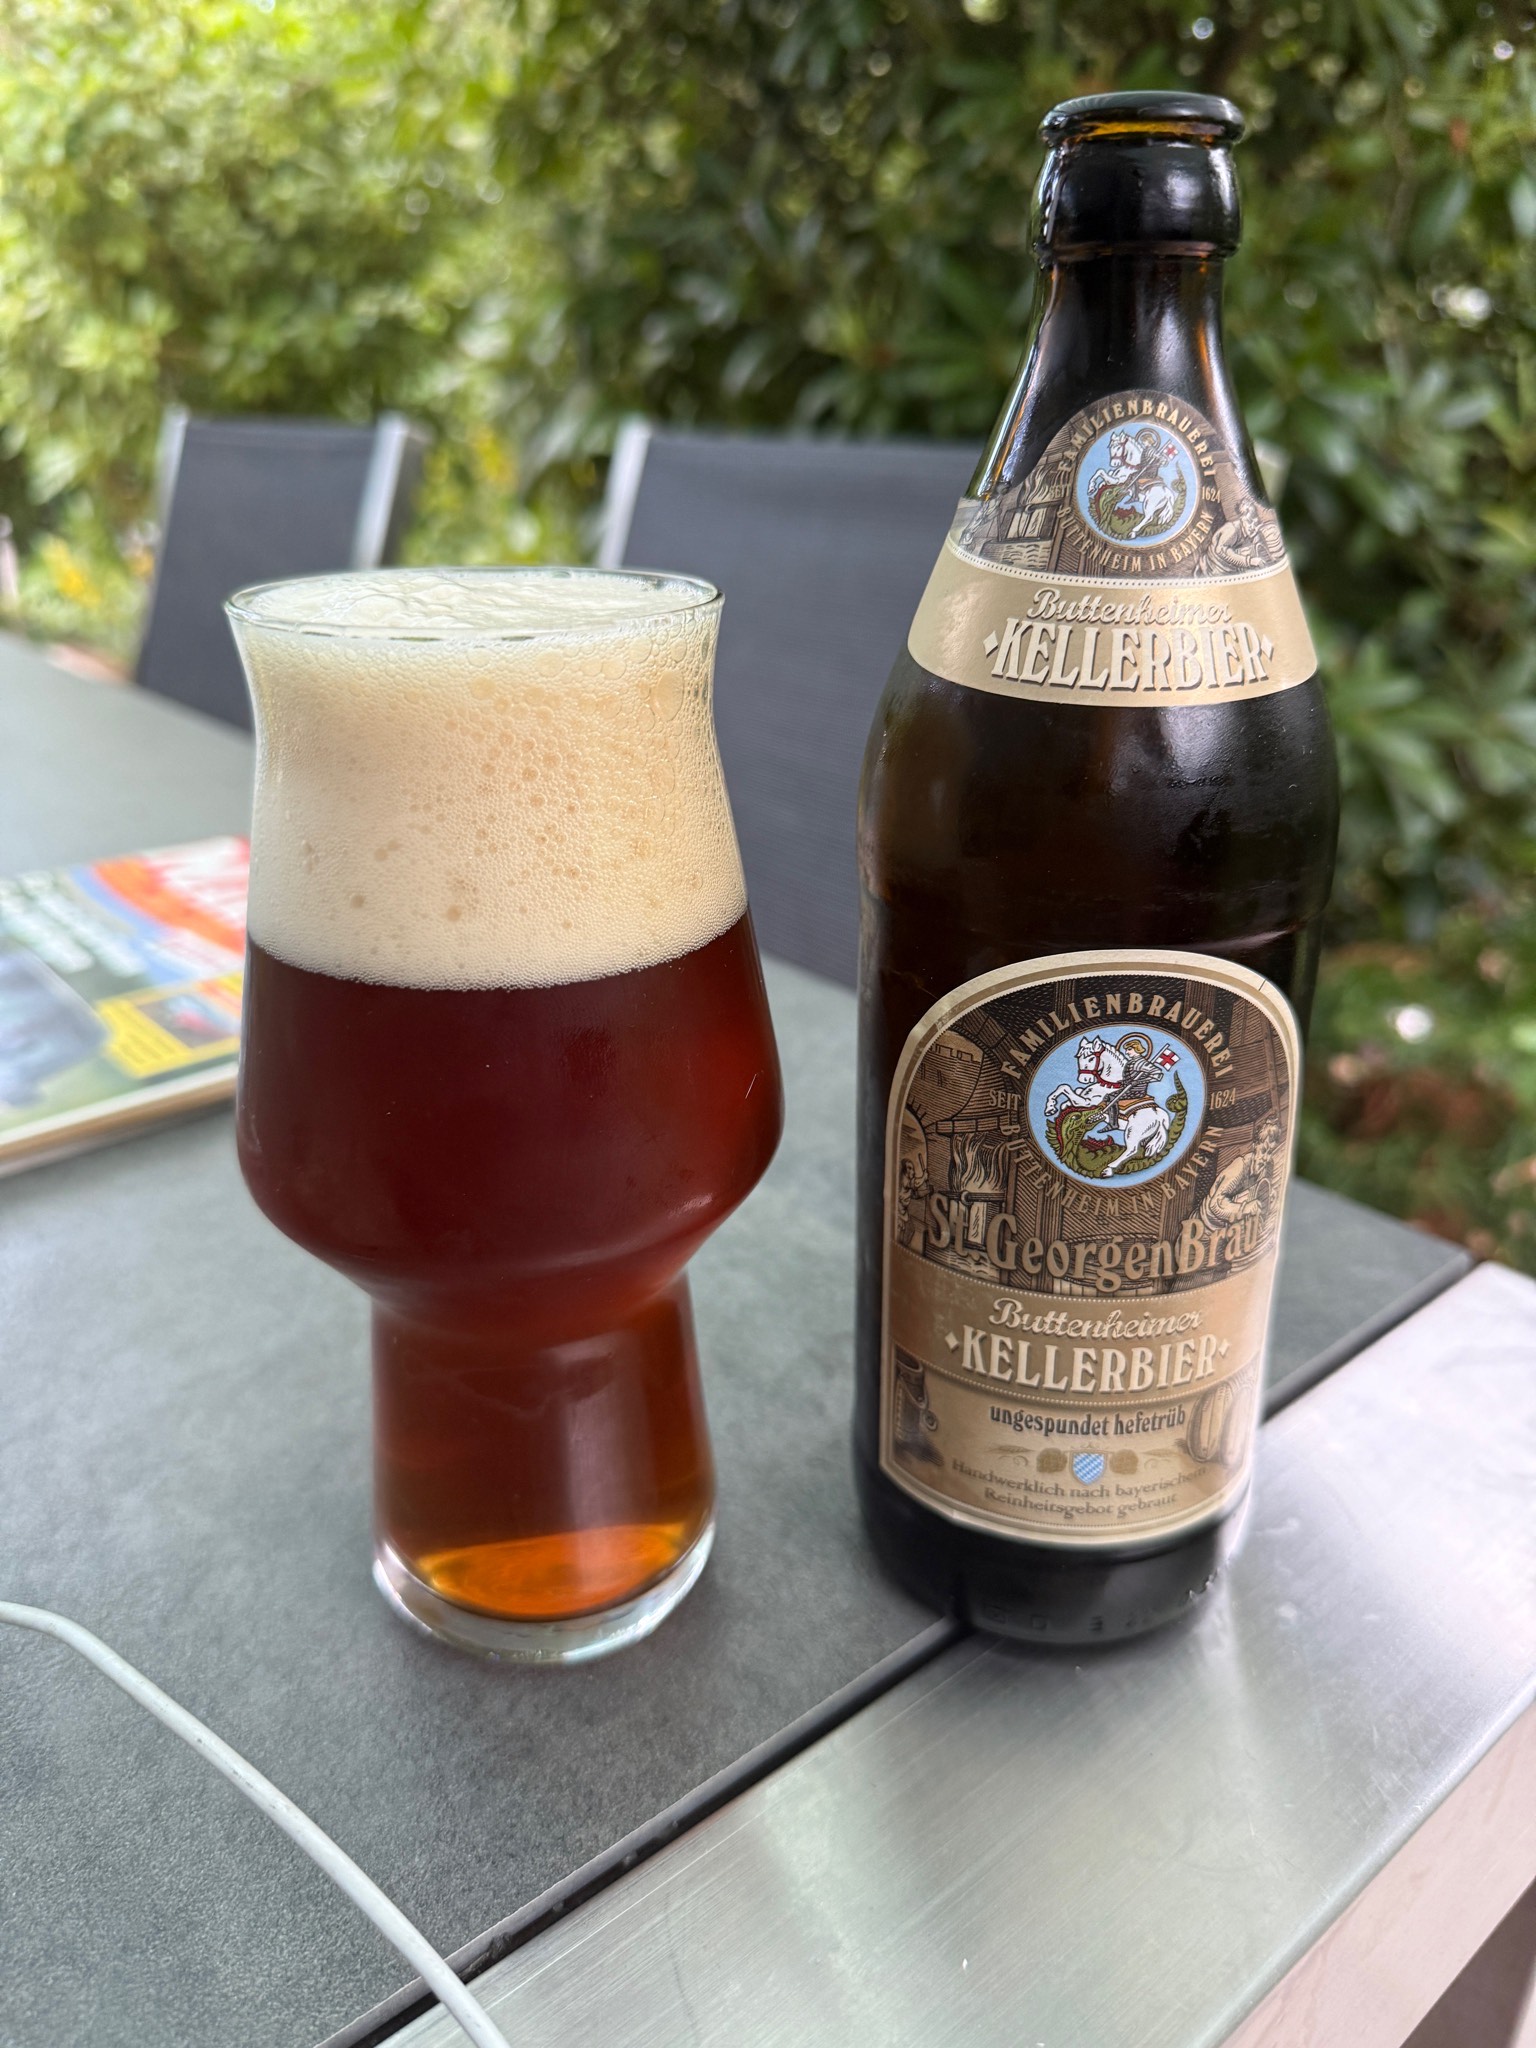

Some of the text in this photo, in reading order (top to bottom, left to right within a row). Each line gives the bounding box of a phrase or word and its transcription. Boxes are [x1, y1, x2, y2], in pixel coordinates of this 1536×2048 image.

[1057, 399, 1217, 476] FAMILIENBRAUEREI
[1201, 486, 1221, 504] 1624
[1056, 505, 1215, 572] BUTTENHEIM IN BAYERN
[1026, 588, 1232, 626] Buttenheimer
[991, 618, 1270, 692] KELLERBIER
[1001, 993, 1235, 1080] FAMILIENBRAUEREI
[988, 1089, 1022, 1111] SEIT
[1209, 1089, 1237, 1111] 1624
[1002, 1124, 1225, 1217] BUTTENHEIM IN BAYERN
[988, 1297, 1204, 1340] Buttenheimer
[961, 1325, 1217, 1395] KELLERBIER
[989, 1404, 1186, 1437] ungespundet hefetrüb
[951, 1458, 1065, 1498] Handwerklich
[1069, 1484, 1110, 1499] nach
[984, 1487, 1178, 1520] Reinheitsgebot gebraut
